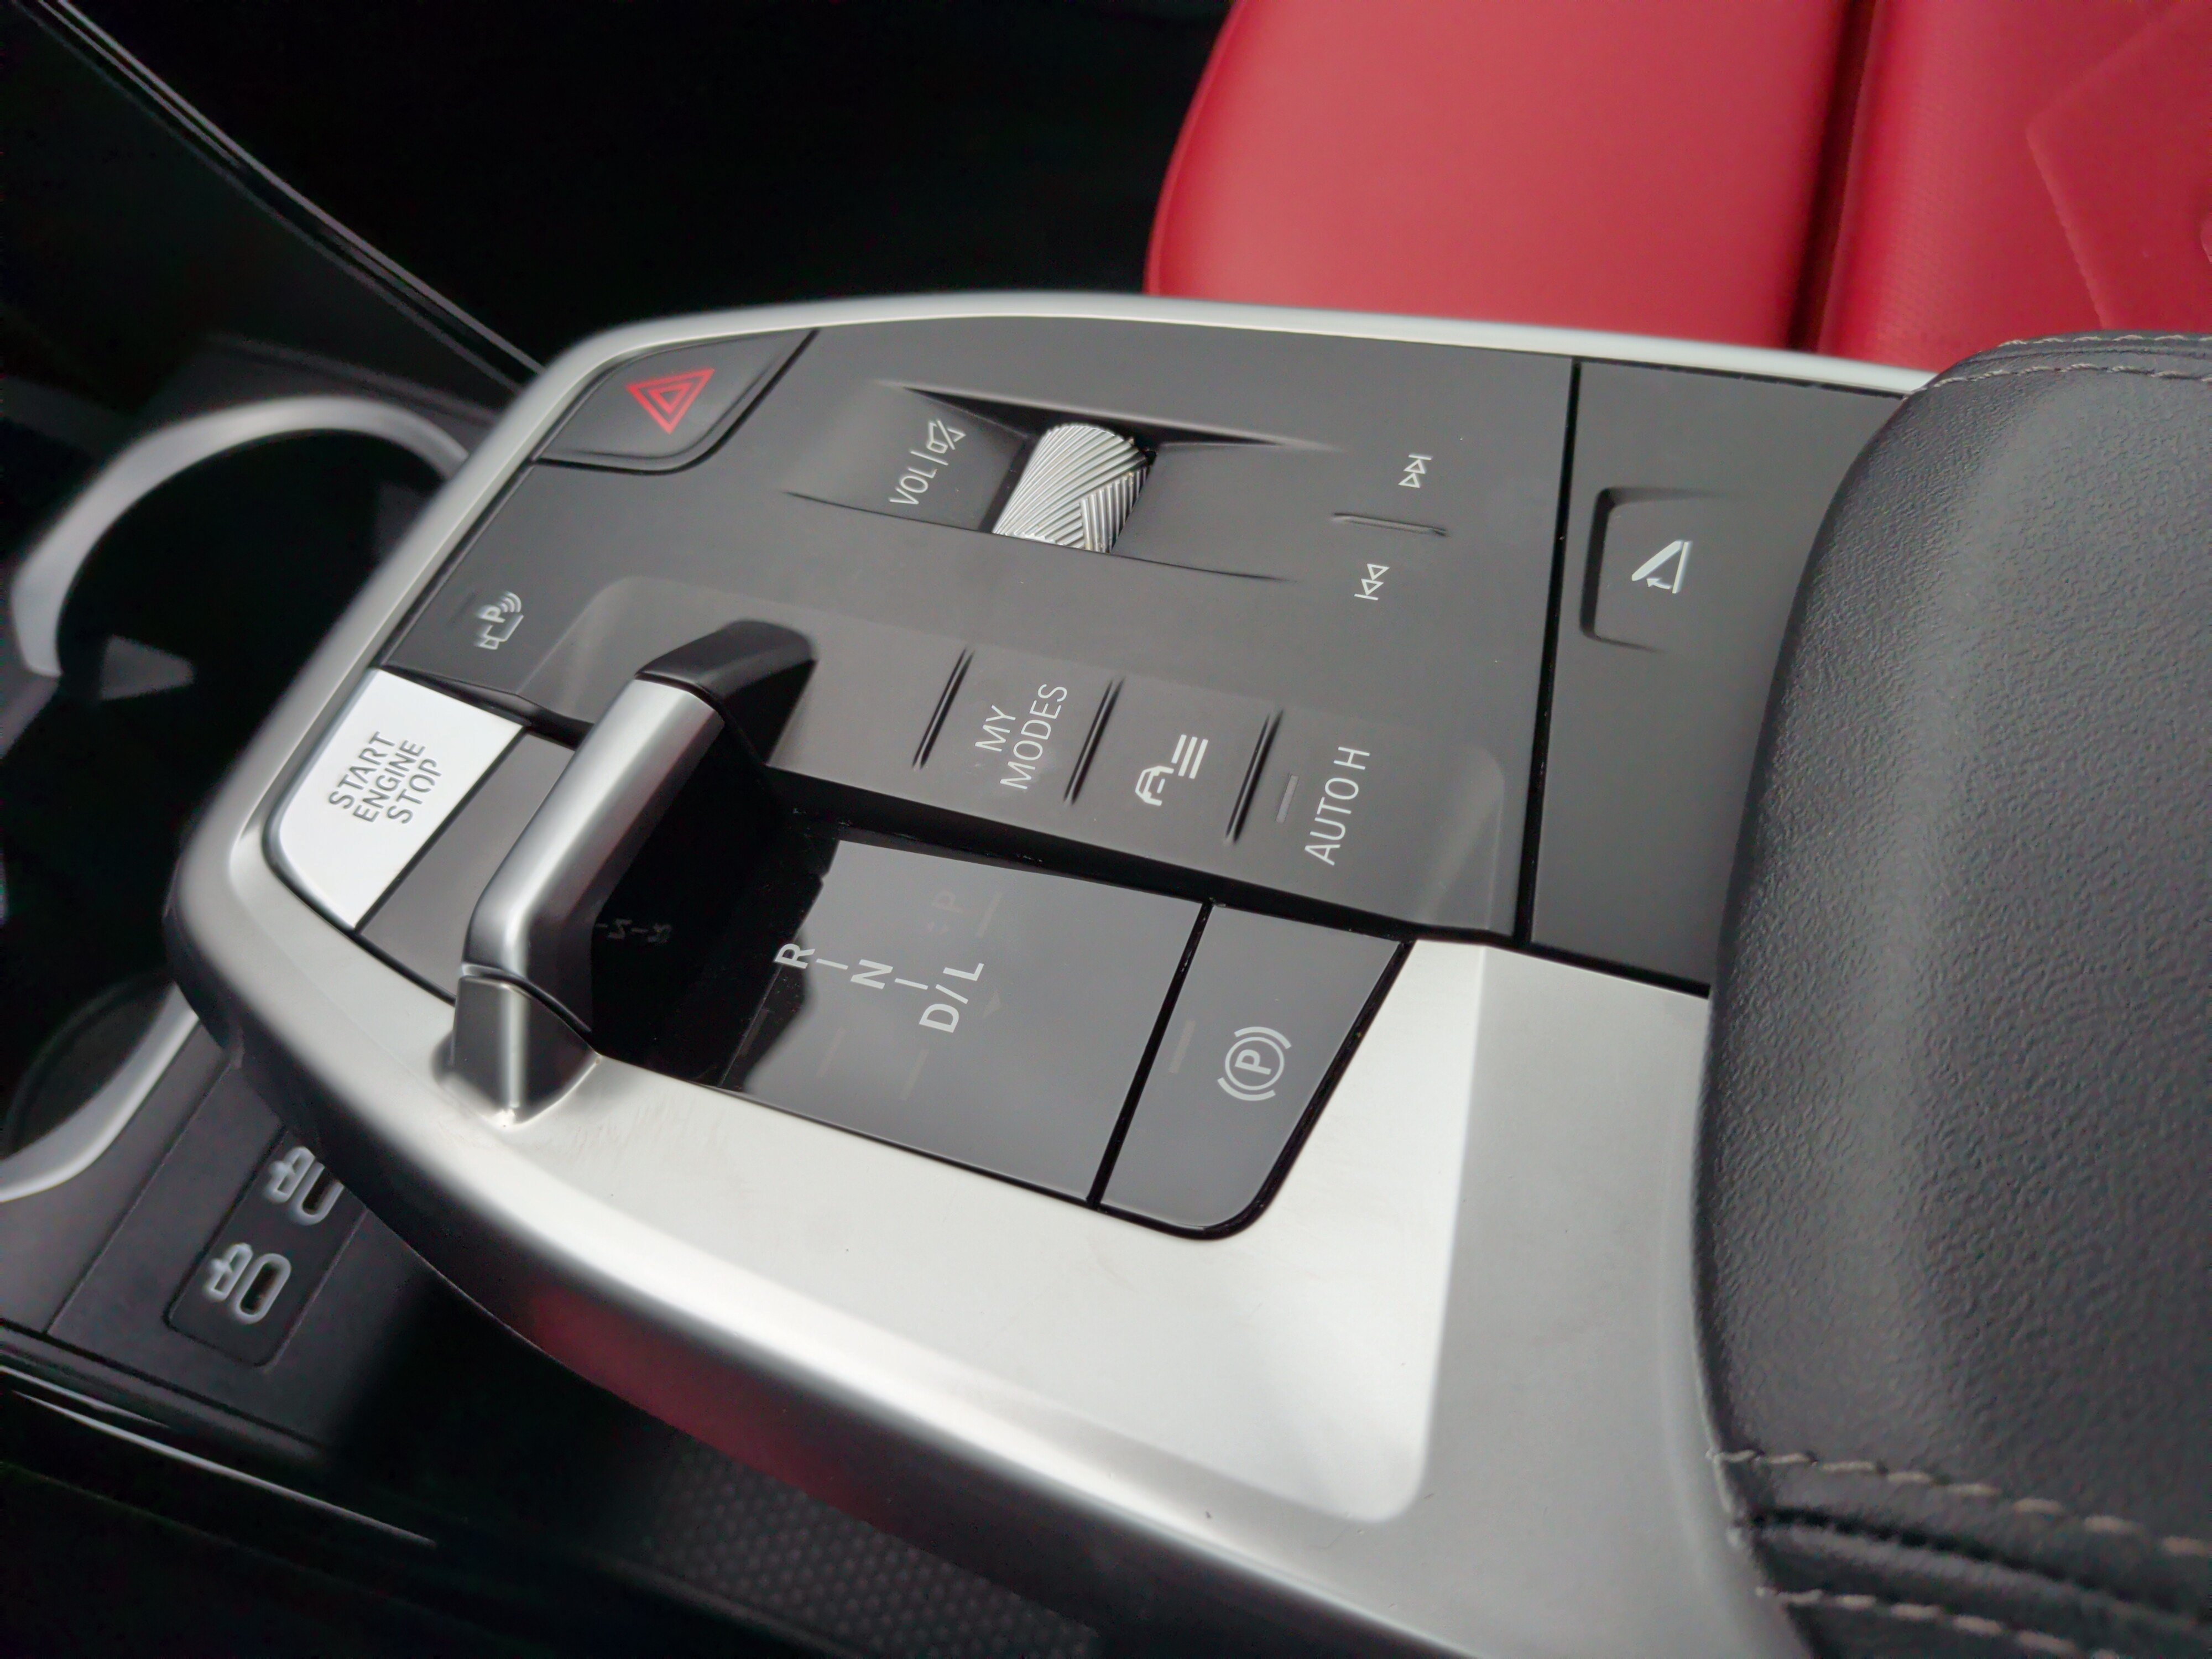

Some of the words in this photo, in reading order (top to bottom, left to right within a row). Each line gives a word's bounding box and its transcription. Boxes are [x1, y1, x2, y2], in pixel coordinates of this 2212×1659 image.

[888, 467, 937, 504] VOL
[974, 704, 1016, 752] MY
[999, 684, 1068, 790] MODES
[328, 731, 395, 810] START
[352, 739, 426, 823] ENGINE
[387, 758, 442, 824] STOP
[1304, 777, 1359, 866] AUTO
[1333, 746, 1370, 770] H
[774, 943, 816, 969] R
[850, 958, 894, 990] N
[919, 962, 985, 1034] D/L
[1234, 1048, 1272, 1076] P
